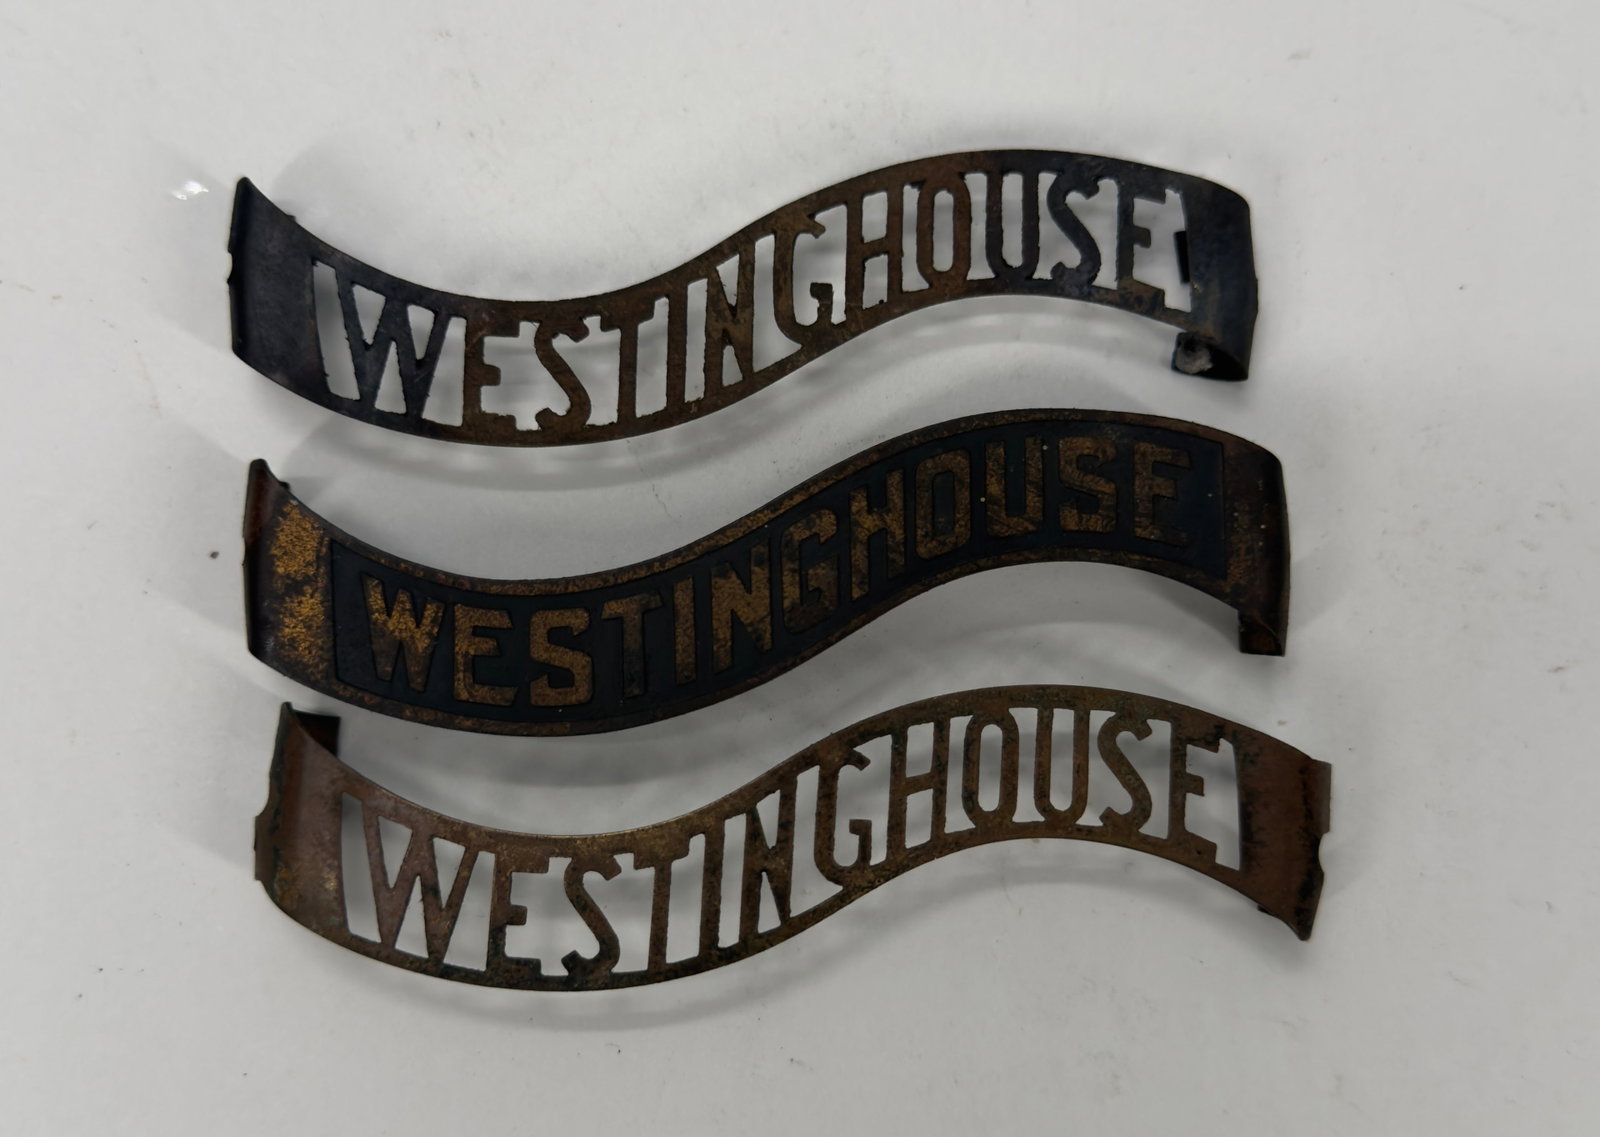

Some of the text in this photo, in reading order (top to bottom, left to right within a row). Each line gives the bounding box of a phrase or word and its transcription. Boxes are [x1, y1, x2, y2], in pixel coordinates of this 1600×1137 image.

[333, 168, 1168, 432] WESTINGHOUSE
[361, 436, 1192, 707] WESTINGHOUSE
[361, 706, 1220, 977] WESTINGHOUSE
